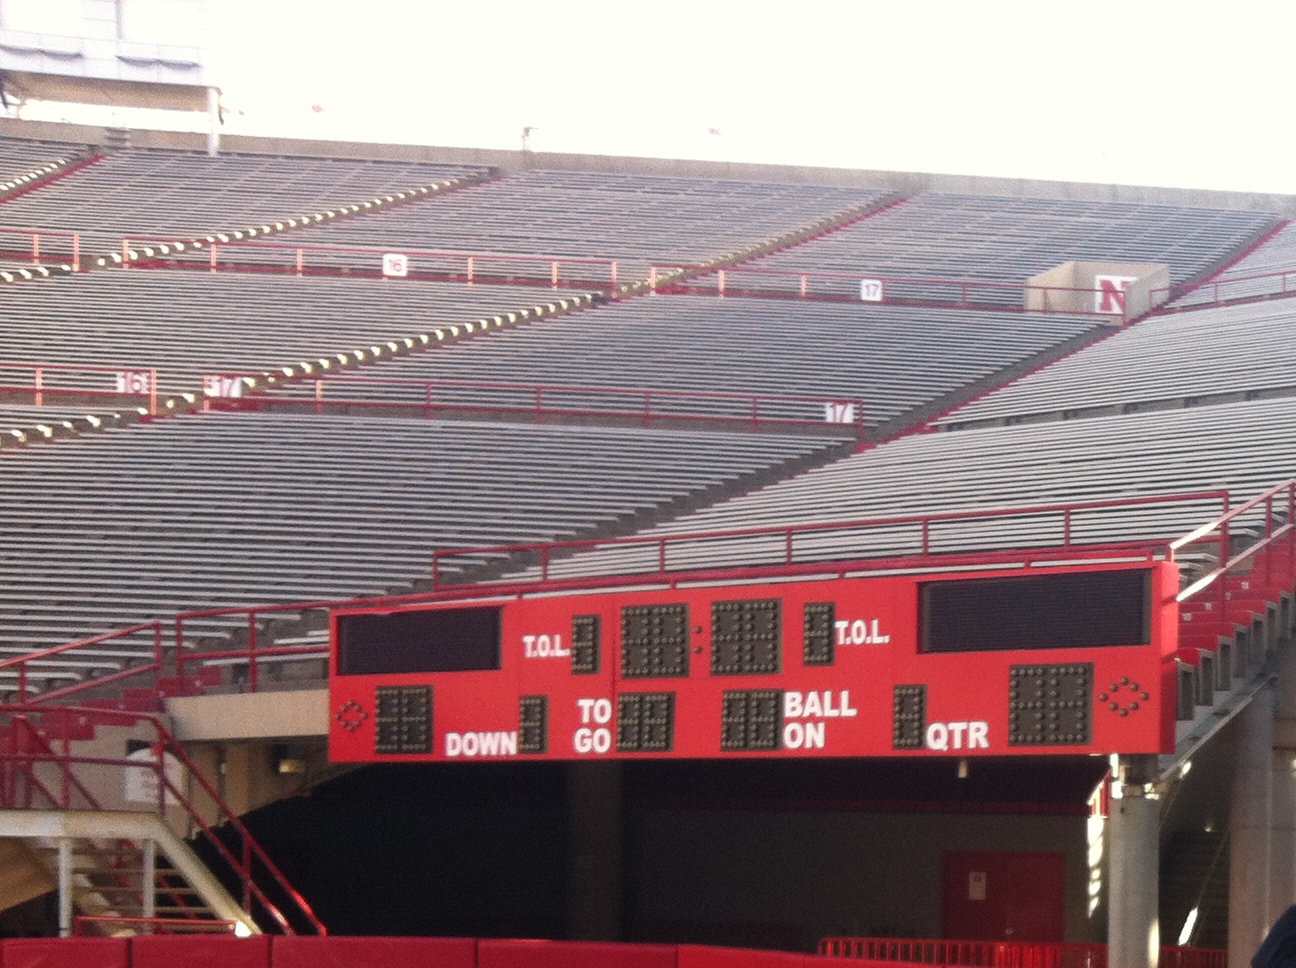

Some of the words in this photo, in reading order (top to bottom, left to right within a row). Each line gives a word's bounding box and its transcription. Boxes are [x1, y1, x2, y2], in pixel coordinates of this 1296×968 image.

[864, 282, 880, 298] 17
[830, 401, 849, 422] 17
[577, 698, 612, 724] TO
[784, 690, 858, 718] BALL
[445, 731, 518, 757] DOWN
[574, 728, 612, 753] GO
[783, 722, 826, 749] ON
[926, 721, 990, 751] QTR
